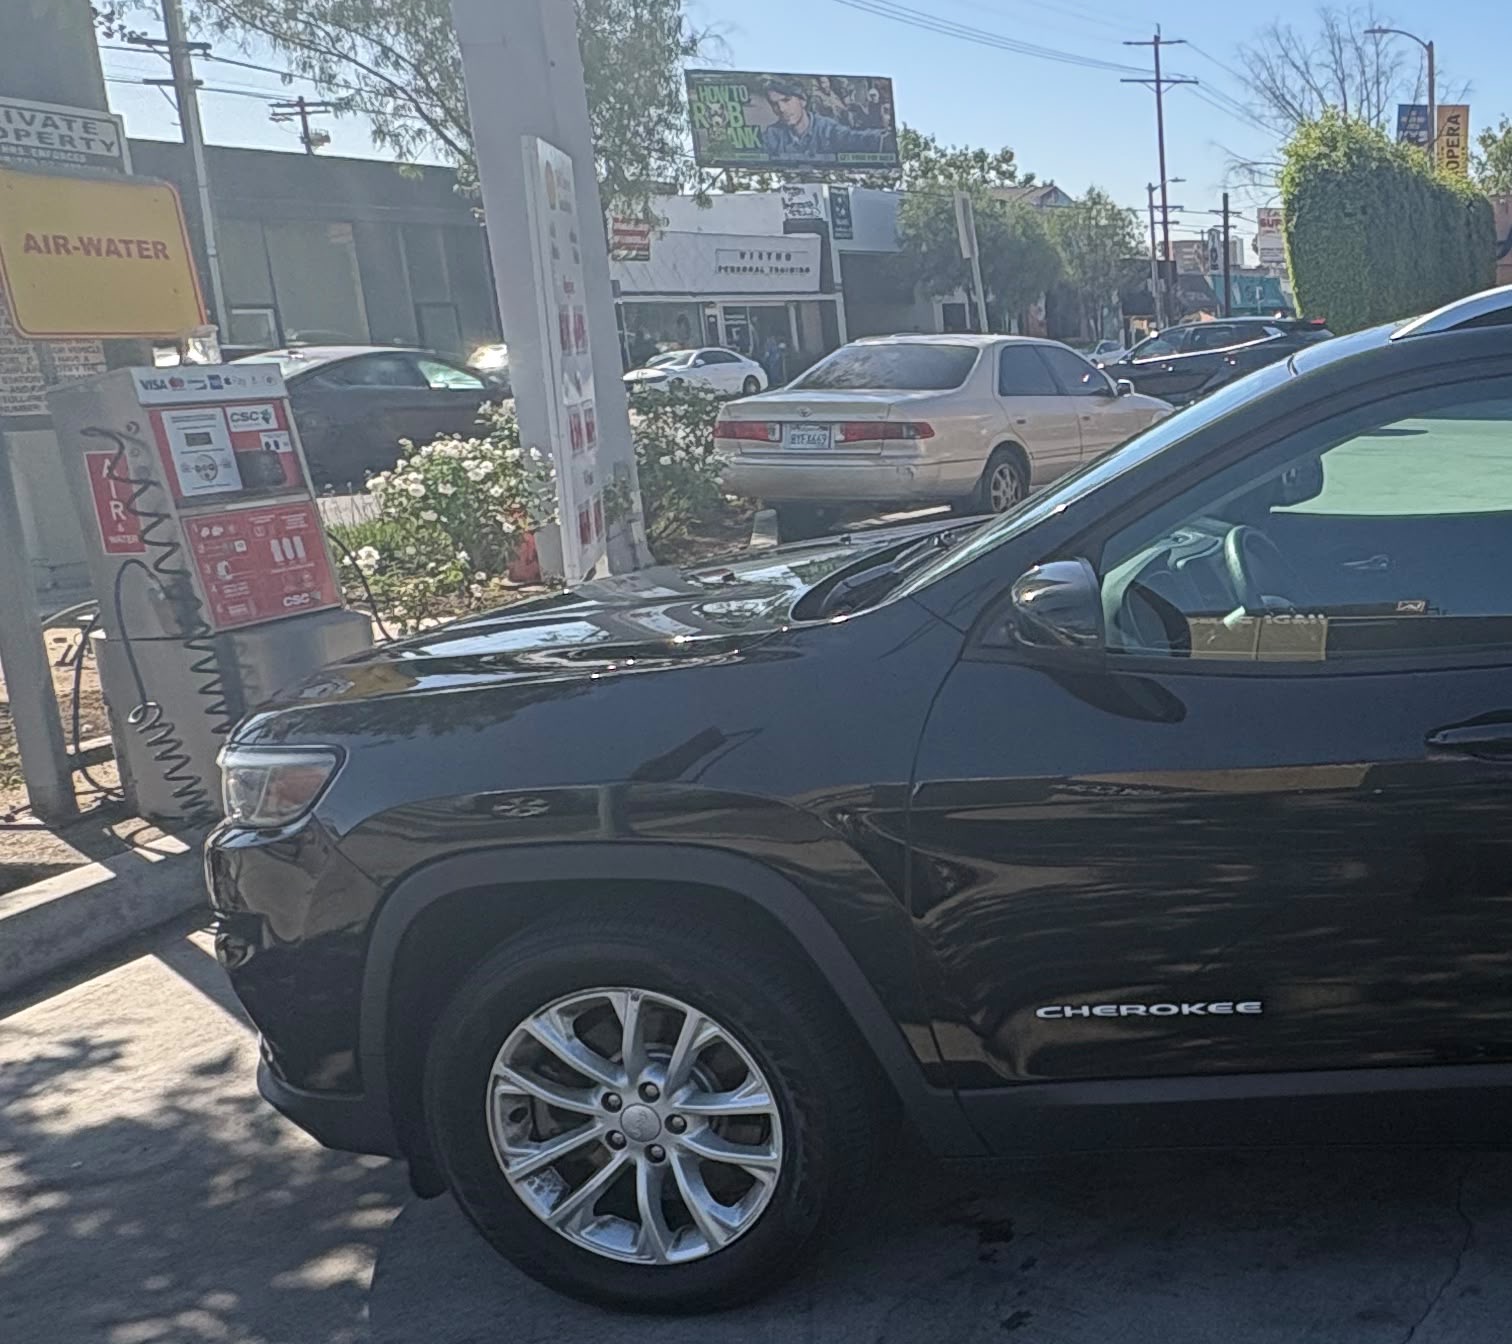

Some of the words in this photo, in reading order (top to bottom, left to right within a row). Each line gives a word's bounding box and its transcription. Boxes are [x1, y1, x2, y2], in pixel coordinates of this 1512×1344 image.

[699, 85, 729, 103] HOW
[729, 84, 749, 102] TO
[724, 125, 762, 149] ANK
[1446, 113, 1462, 171] OPERA
[23, 232, 171, 261] AIR-WATER
[139, 379, 168, 391] VISA
[229, 411, 260, 424] CSC
[283, 592, 311, 607] CSC
[1035, 1000, 1263, 1019] CHEROKEE
